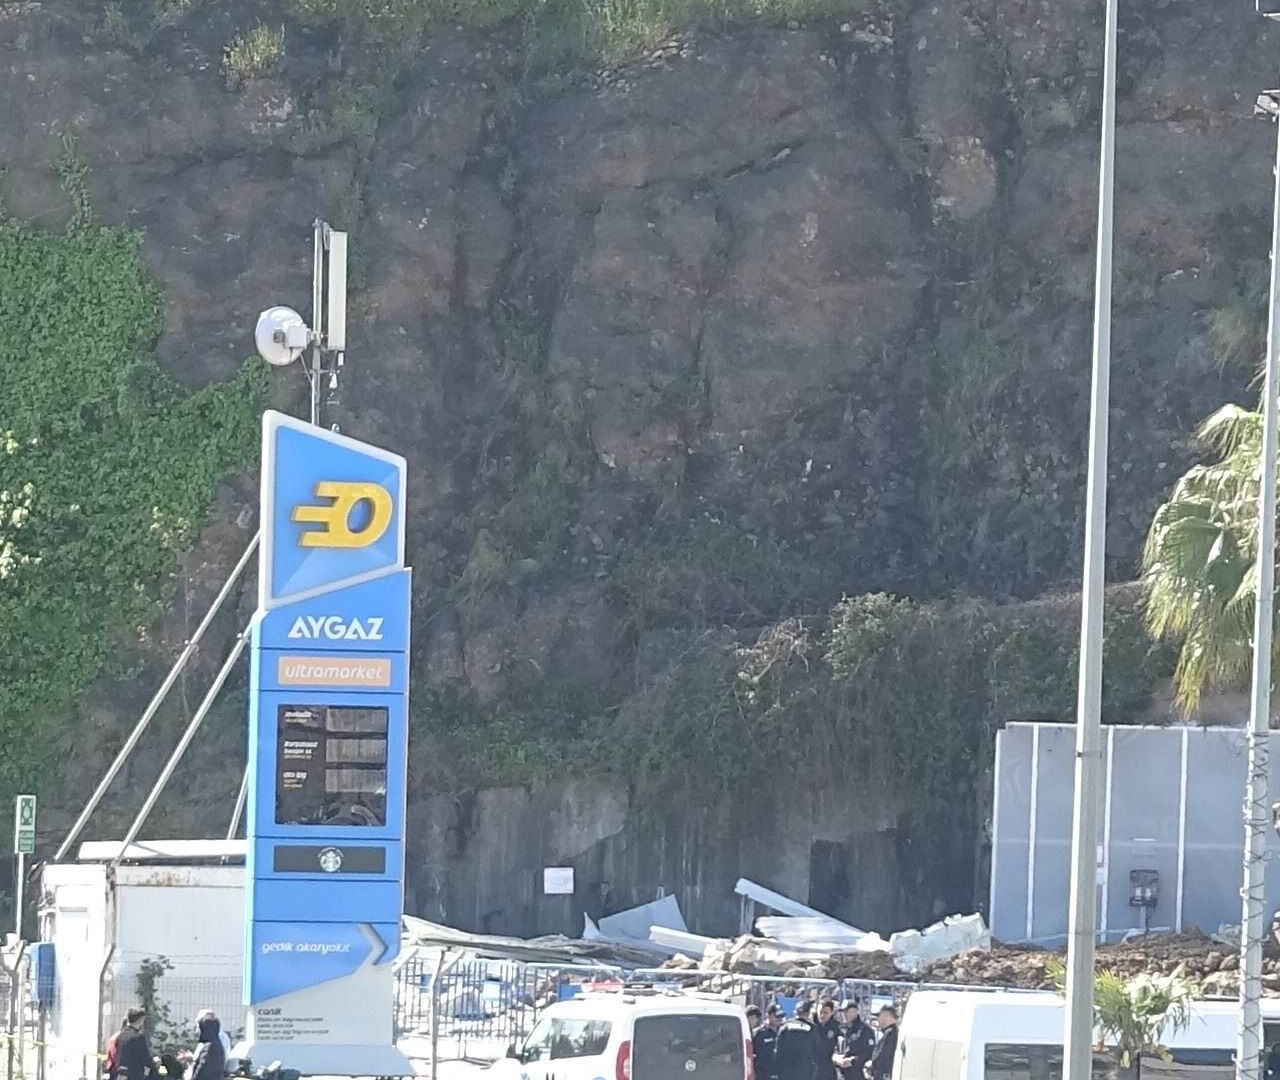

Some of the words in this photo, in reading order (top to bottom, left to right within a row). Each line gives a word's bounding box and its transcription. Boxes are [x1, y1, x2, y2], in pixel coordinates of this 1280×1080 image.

[288, 615, 384, 640] AYGAZ
[285, 663, 383, 679] ultramarket
[262, 942, 294, 955] gedik
